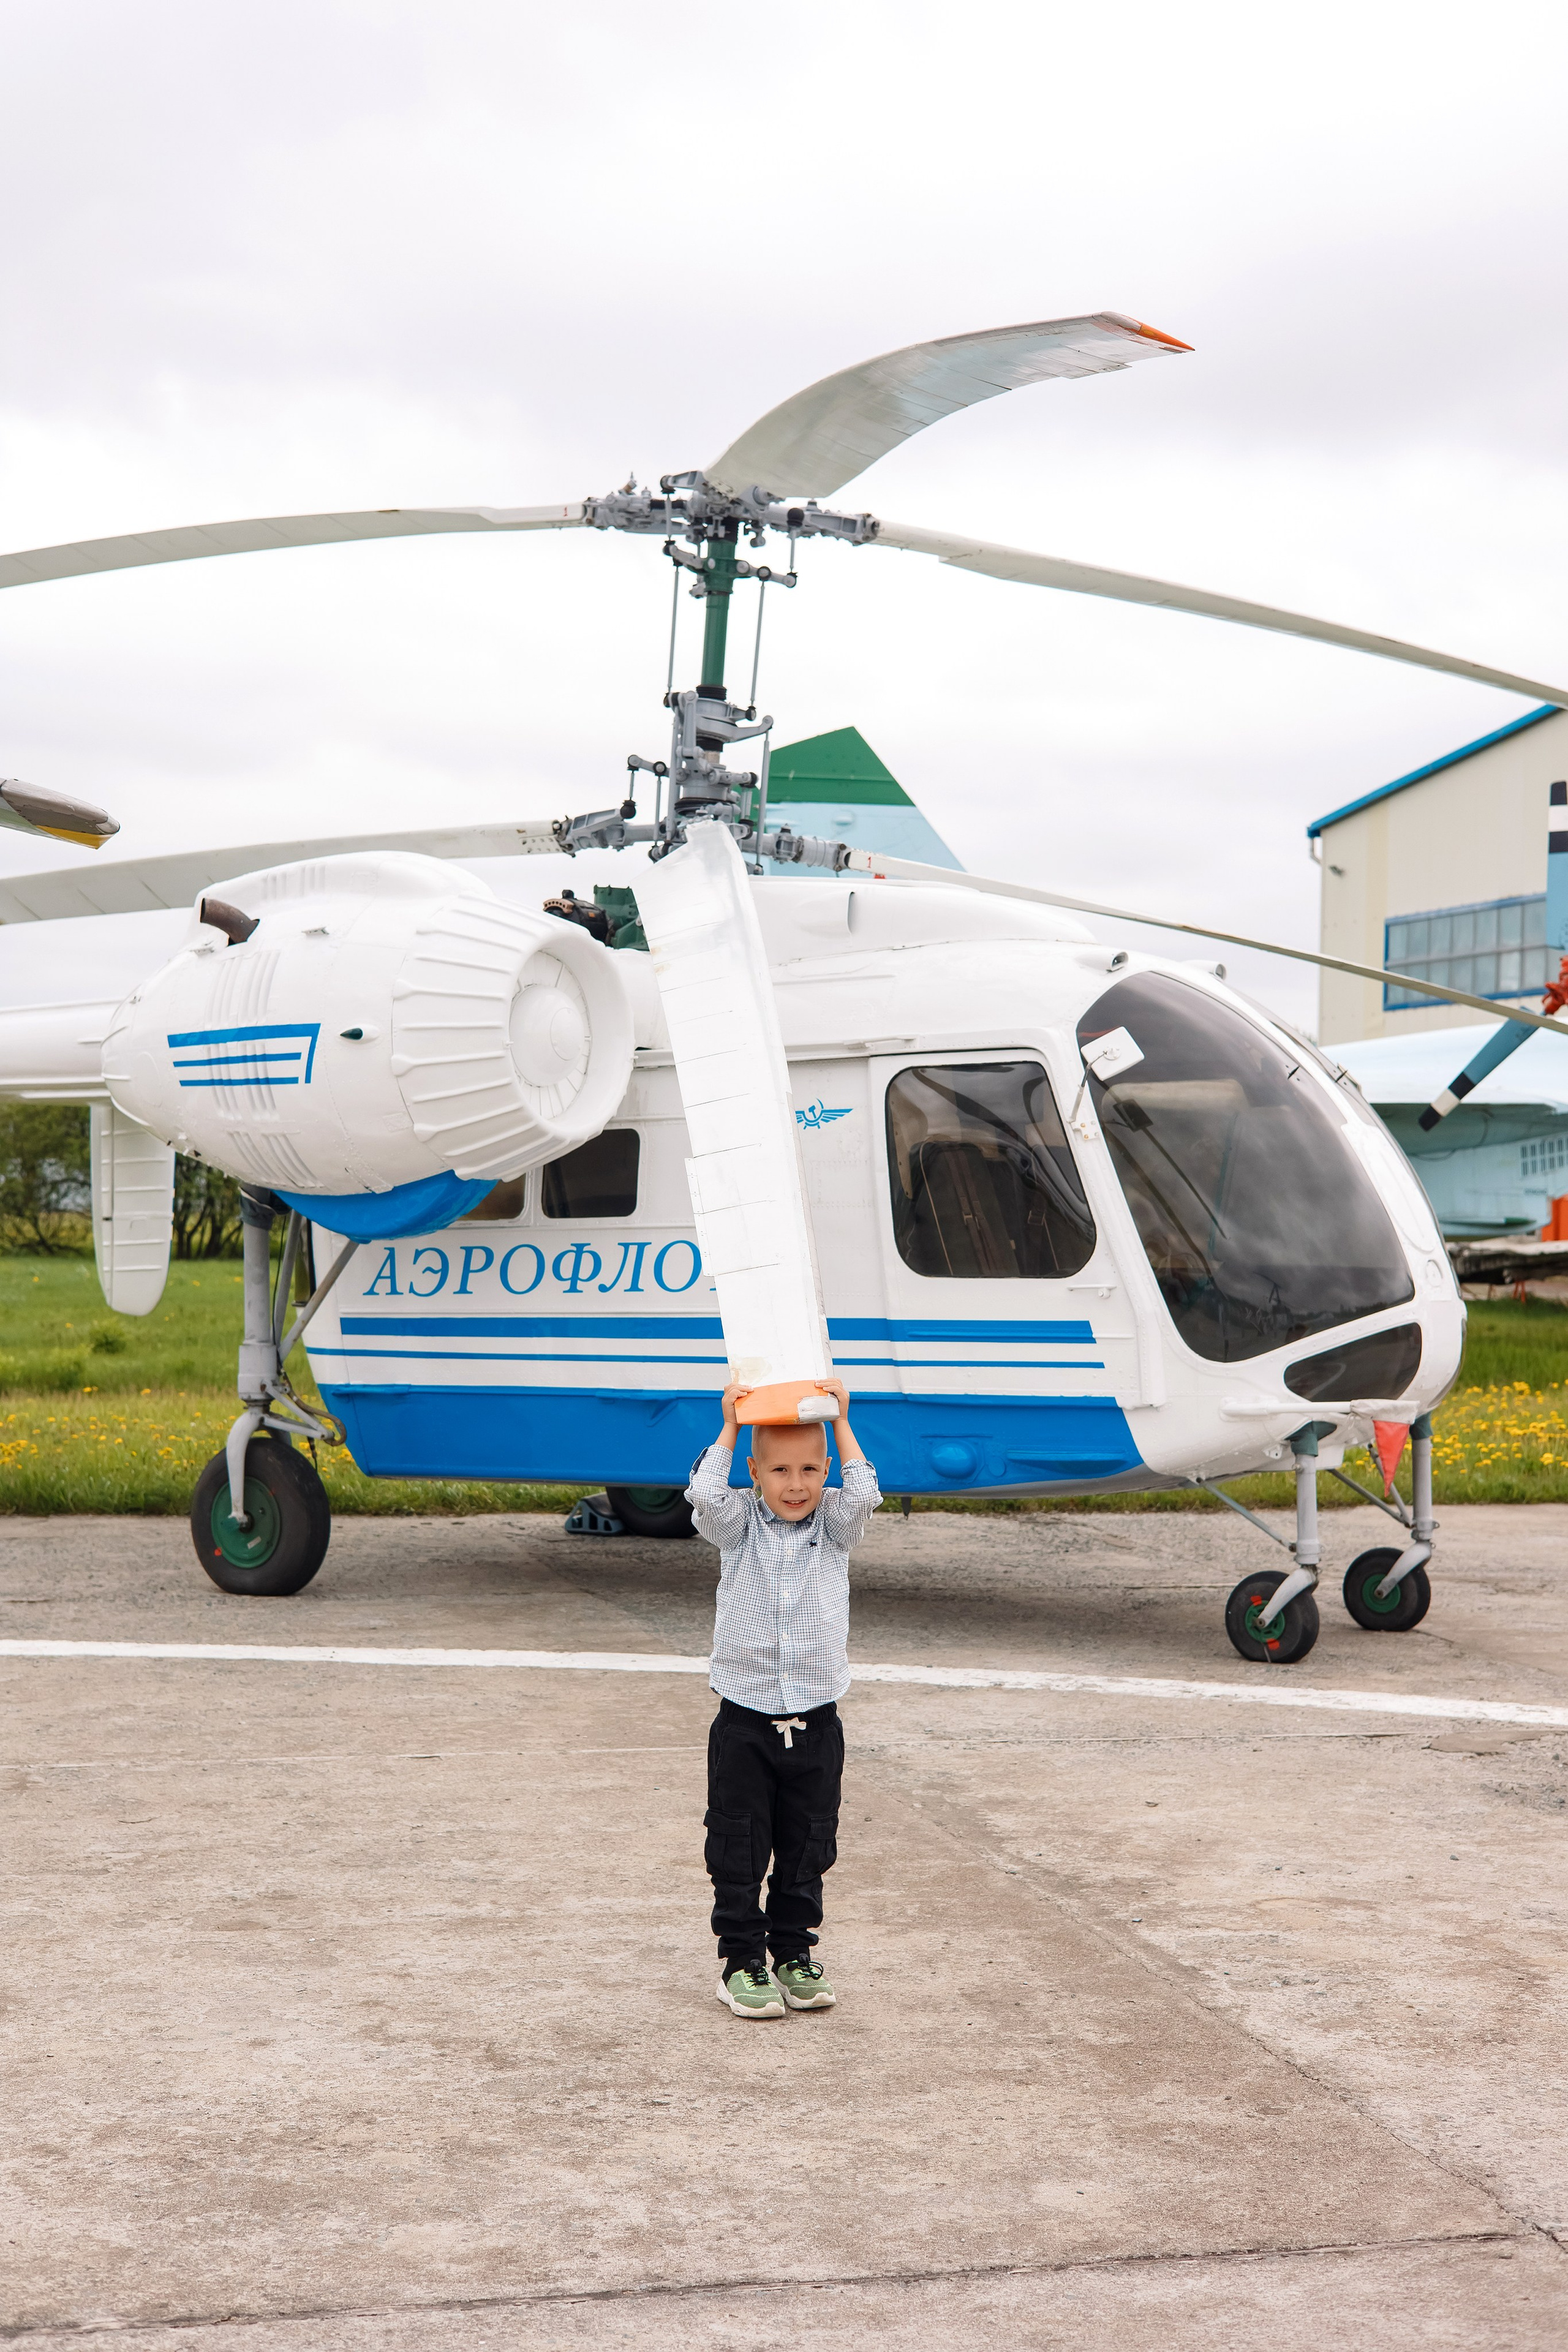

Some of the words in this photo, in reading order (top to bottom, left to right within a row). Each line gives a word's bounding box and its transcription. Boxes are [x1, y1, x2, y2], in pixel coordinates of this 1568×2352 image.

[563, 506, 568, 517] 1
[867, 856, 872, 869] 1
[363, 1240, 717, 1297] АЭРОФЛО
